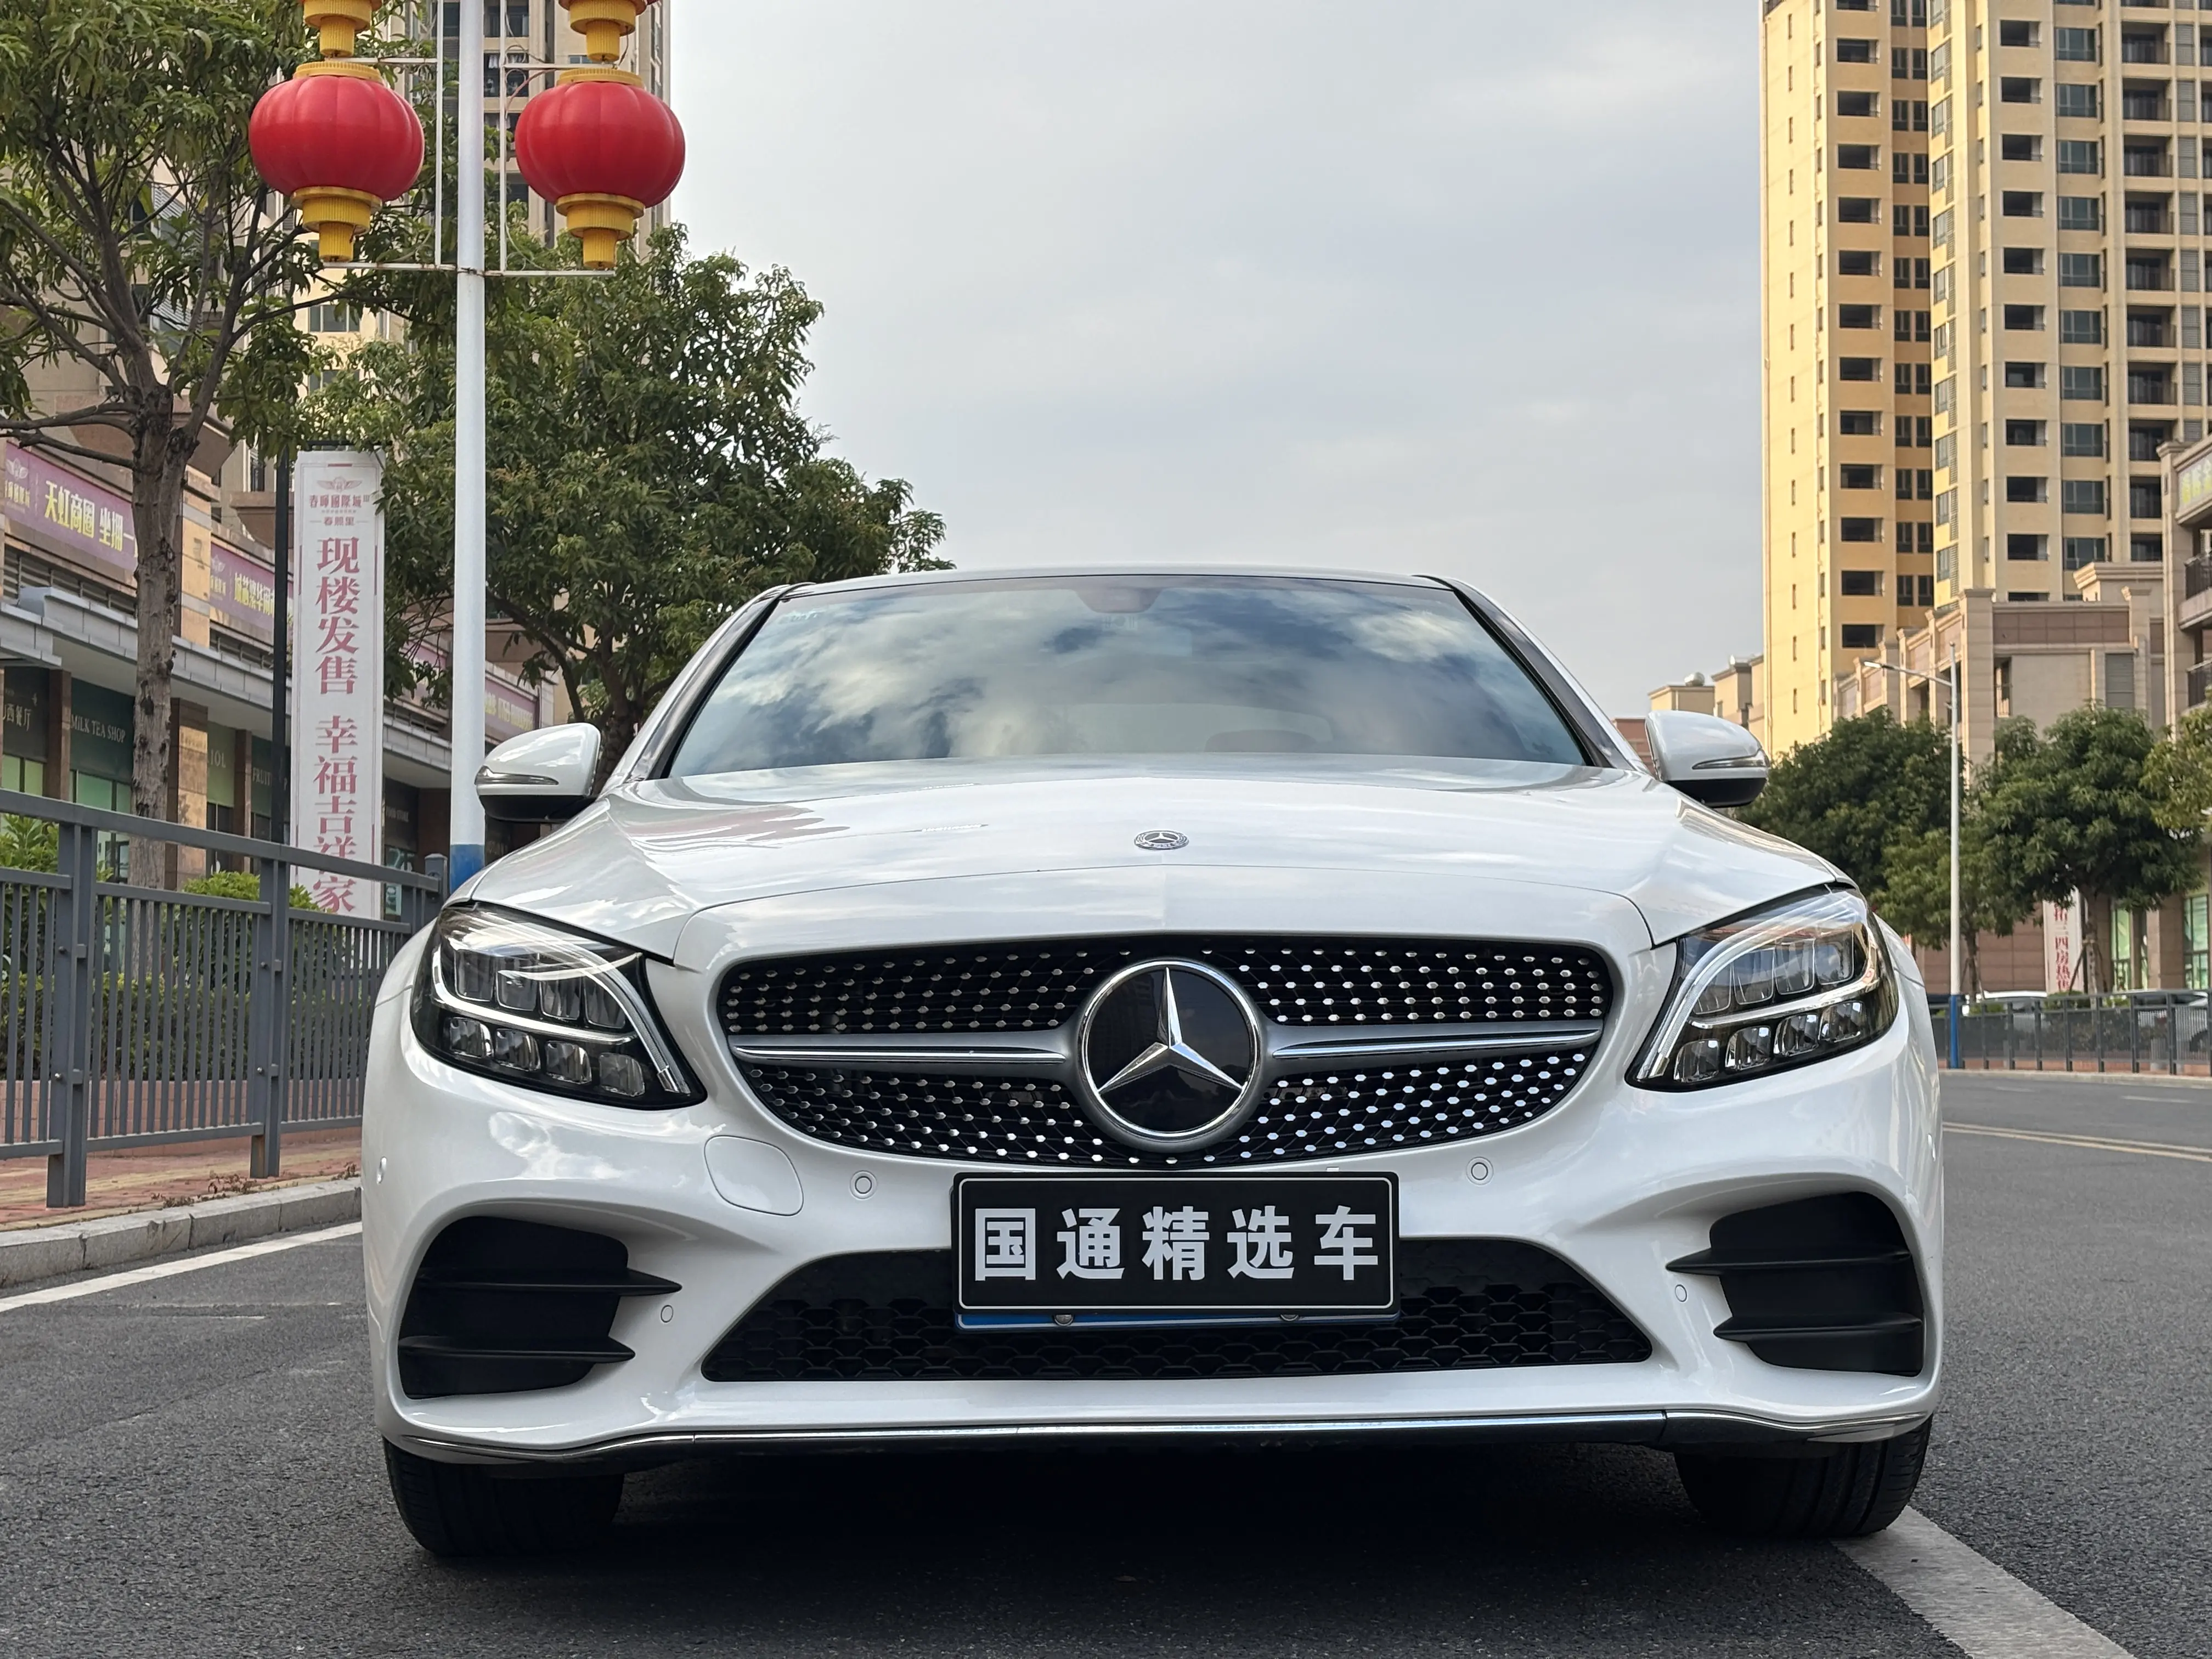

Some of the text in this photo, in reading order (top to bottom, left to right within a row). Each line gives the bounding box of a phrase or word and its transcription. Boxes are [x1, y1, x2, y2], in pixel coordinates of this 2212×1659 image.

[99, 507, 138, 558] 坐拥一
[315, 537, 360, 695] 现楼发售
[3, 703, 32, 731] 西餐厅
[71, 714, 126, 744] MILK TEA SHOP
[974, 1205, 1379, 1282] 国通精选车
